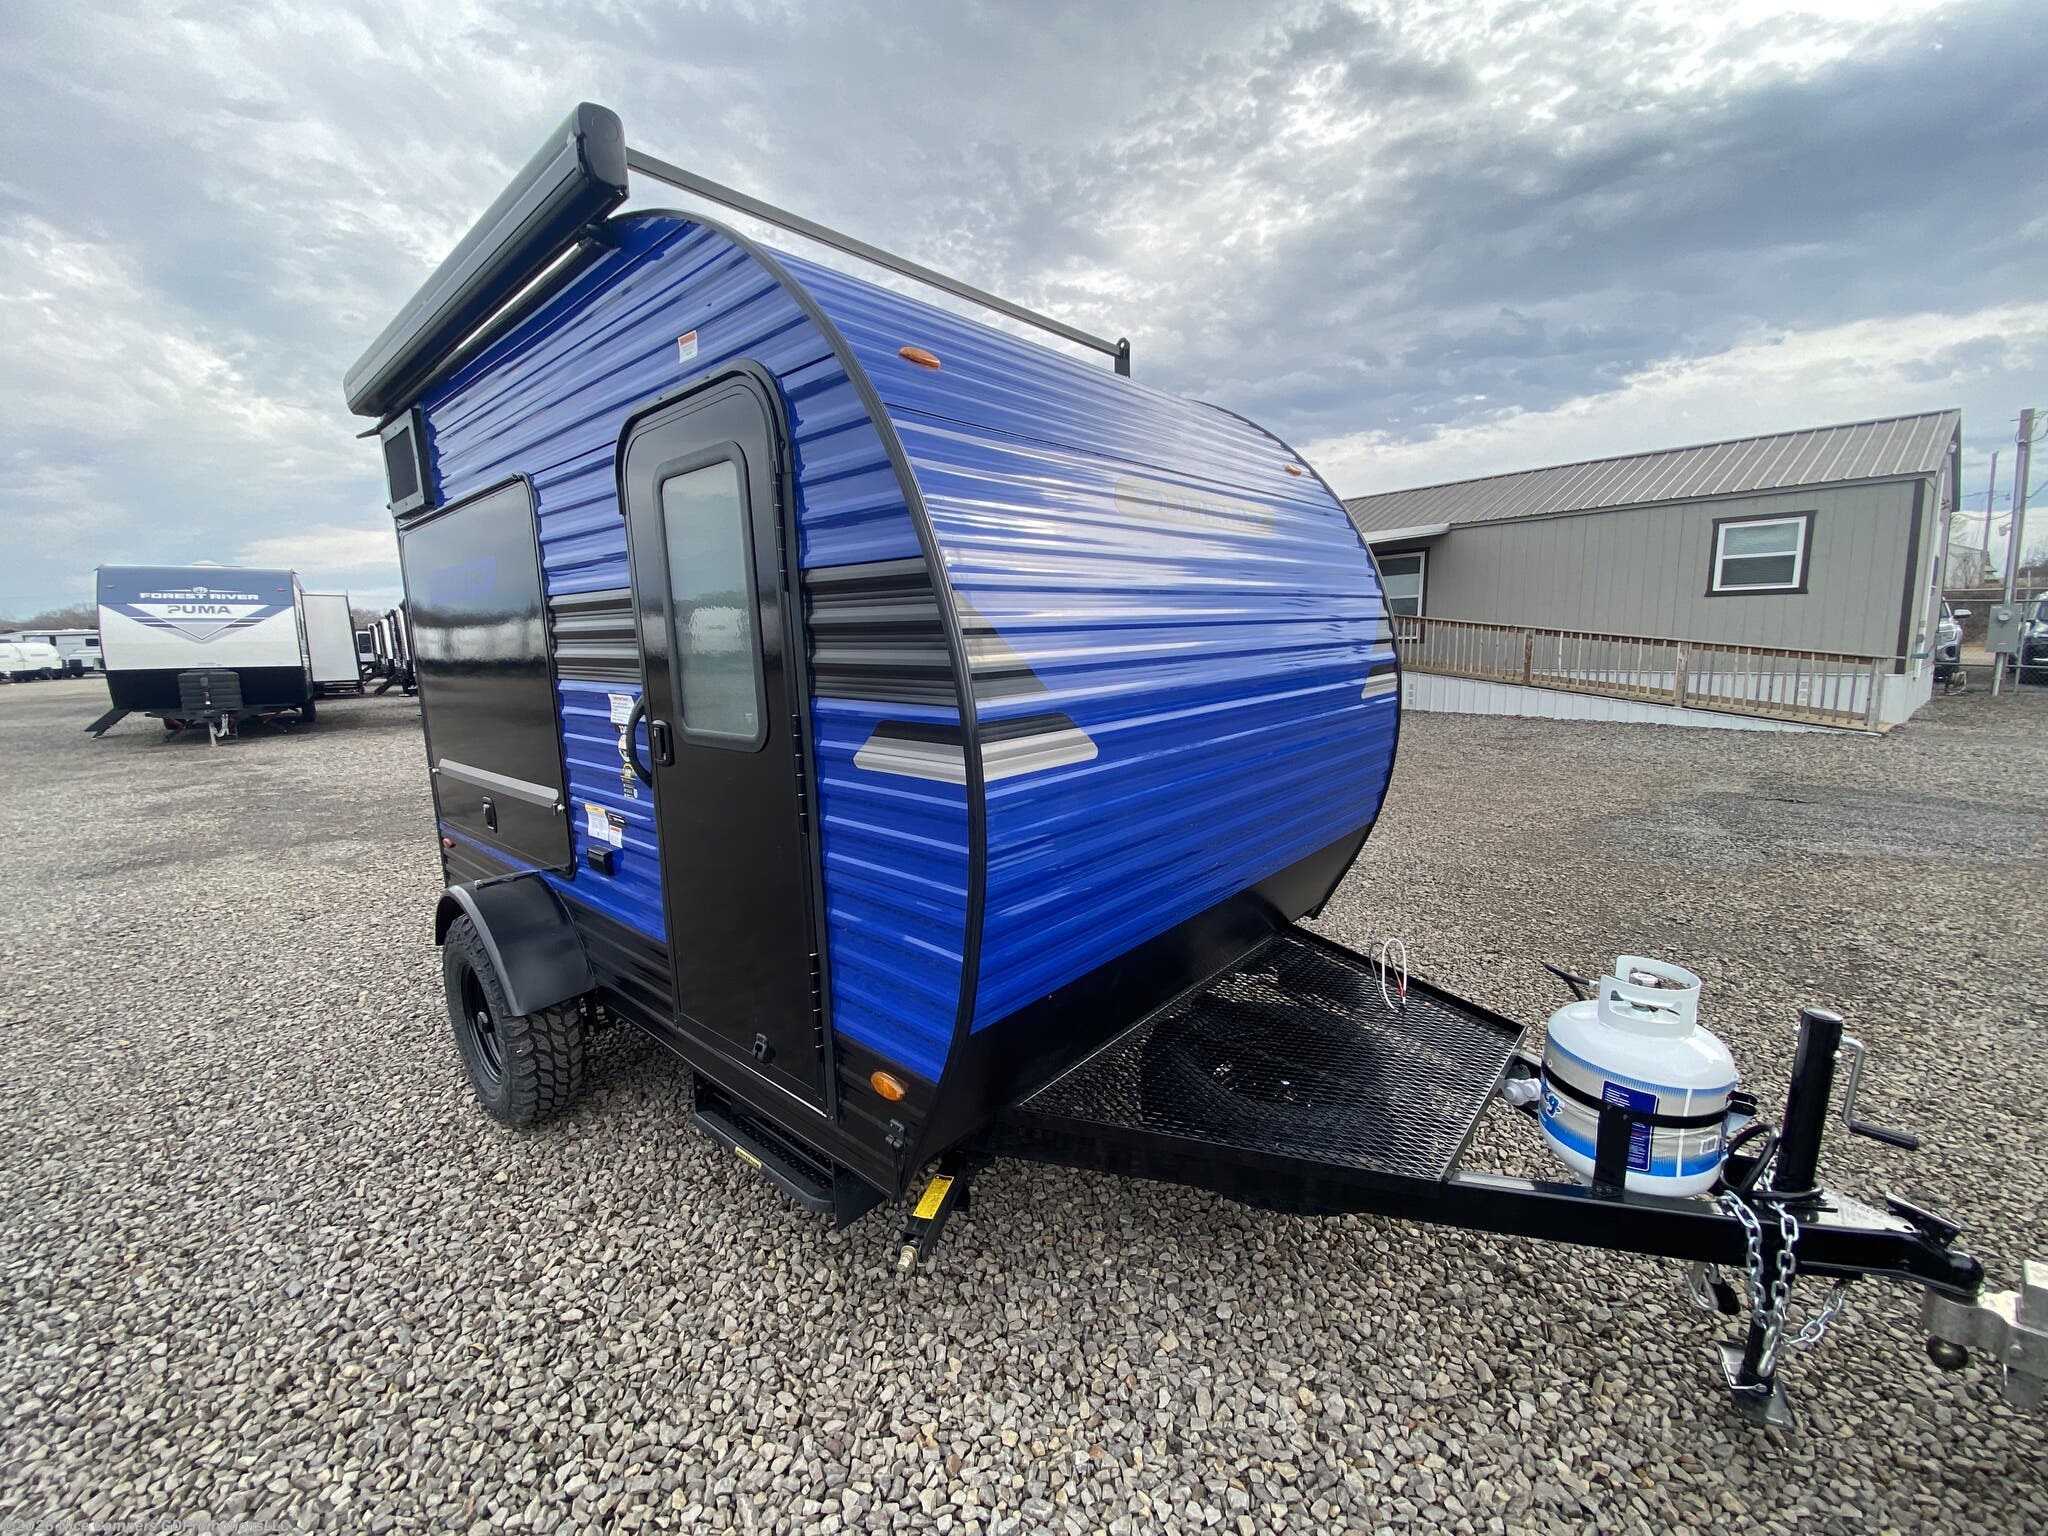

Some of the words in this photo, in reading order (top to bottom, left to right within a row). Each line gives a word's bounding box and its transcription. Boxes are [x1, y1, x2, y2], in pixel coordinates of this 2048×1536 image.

[139, 592, 207, 600] FOREST
[210, 593, 259, 601] RIVER
[167, 605, 232, 614] PUMA
